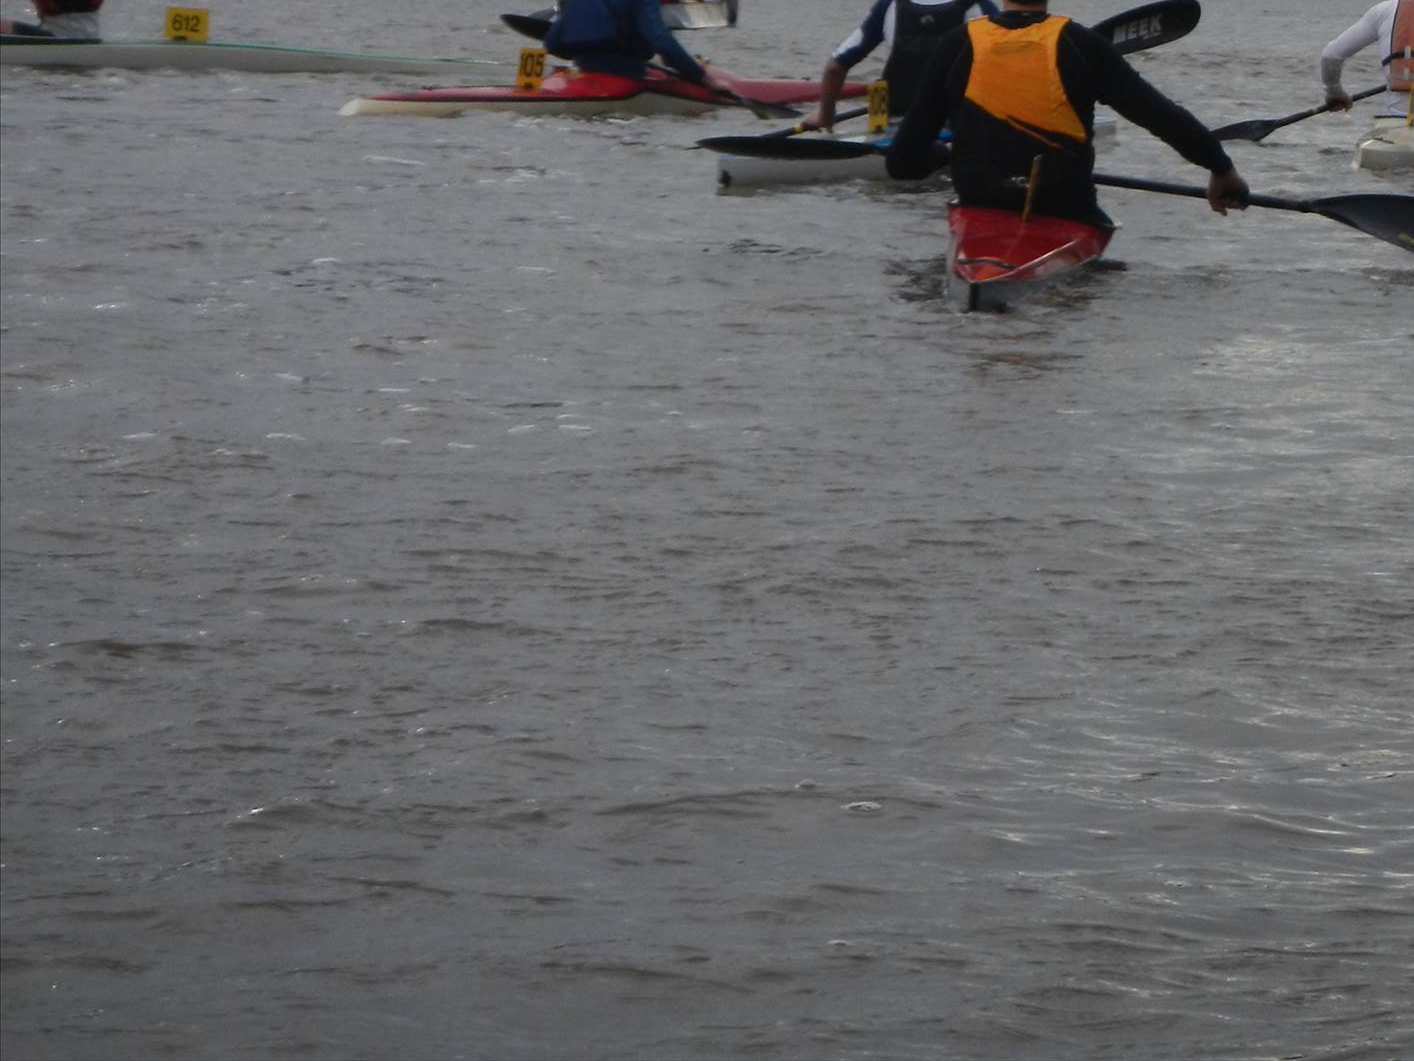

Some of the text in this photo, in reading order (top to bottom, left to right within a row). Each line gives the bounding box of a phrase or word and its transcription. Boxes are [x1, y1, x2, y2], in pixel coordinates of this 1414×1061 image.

[172, 14, 200, 33] 612
[1113, 13, 1163, 44] MEEK
[519, 52, 545, 78] 105
